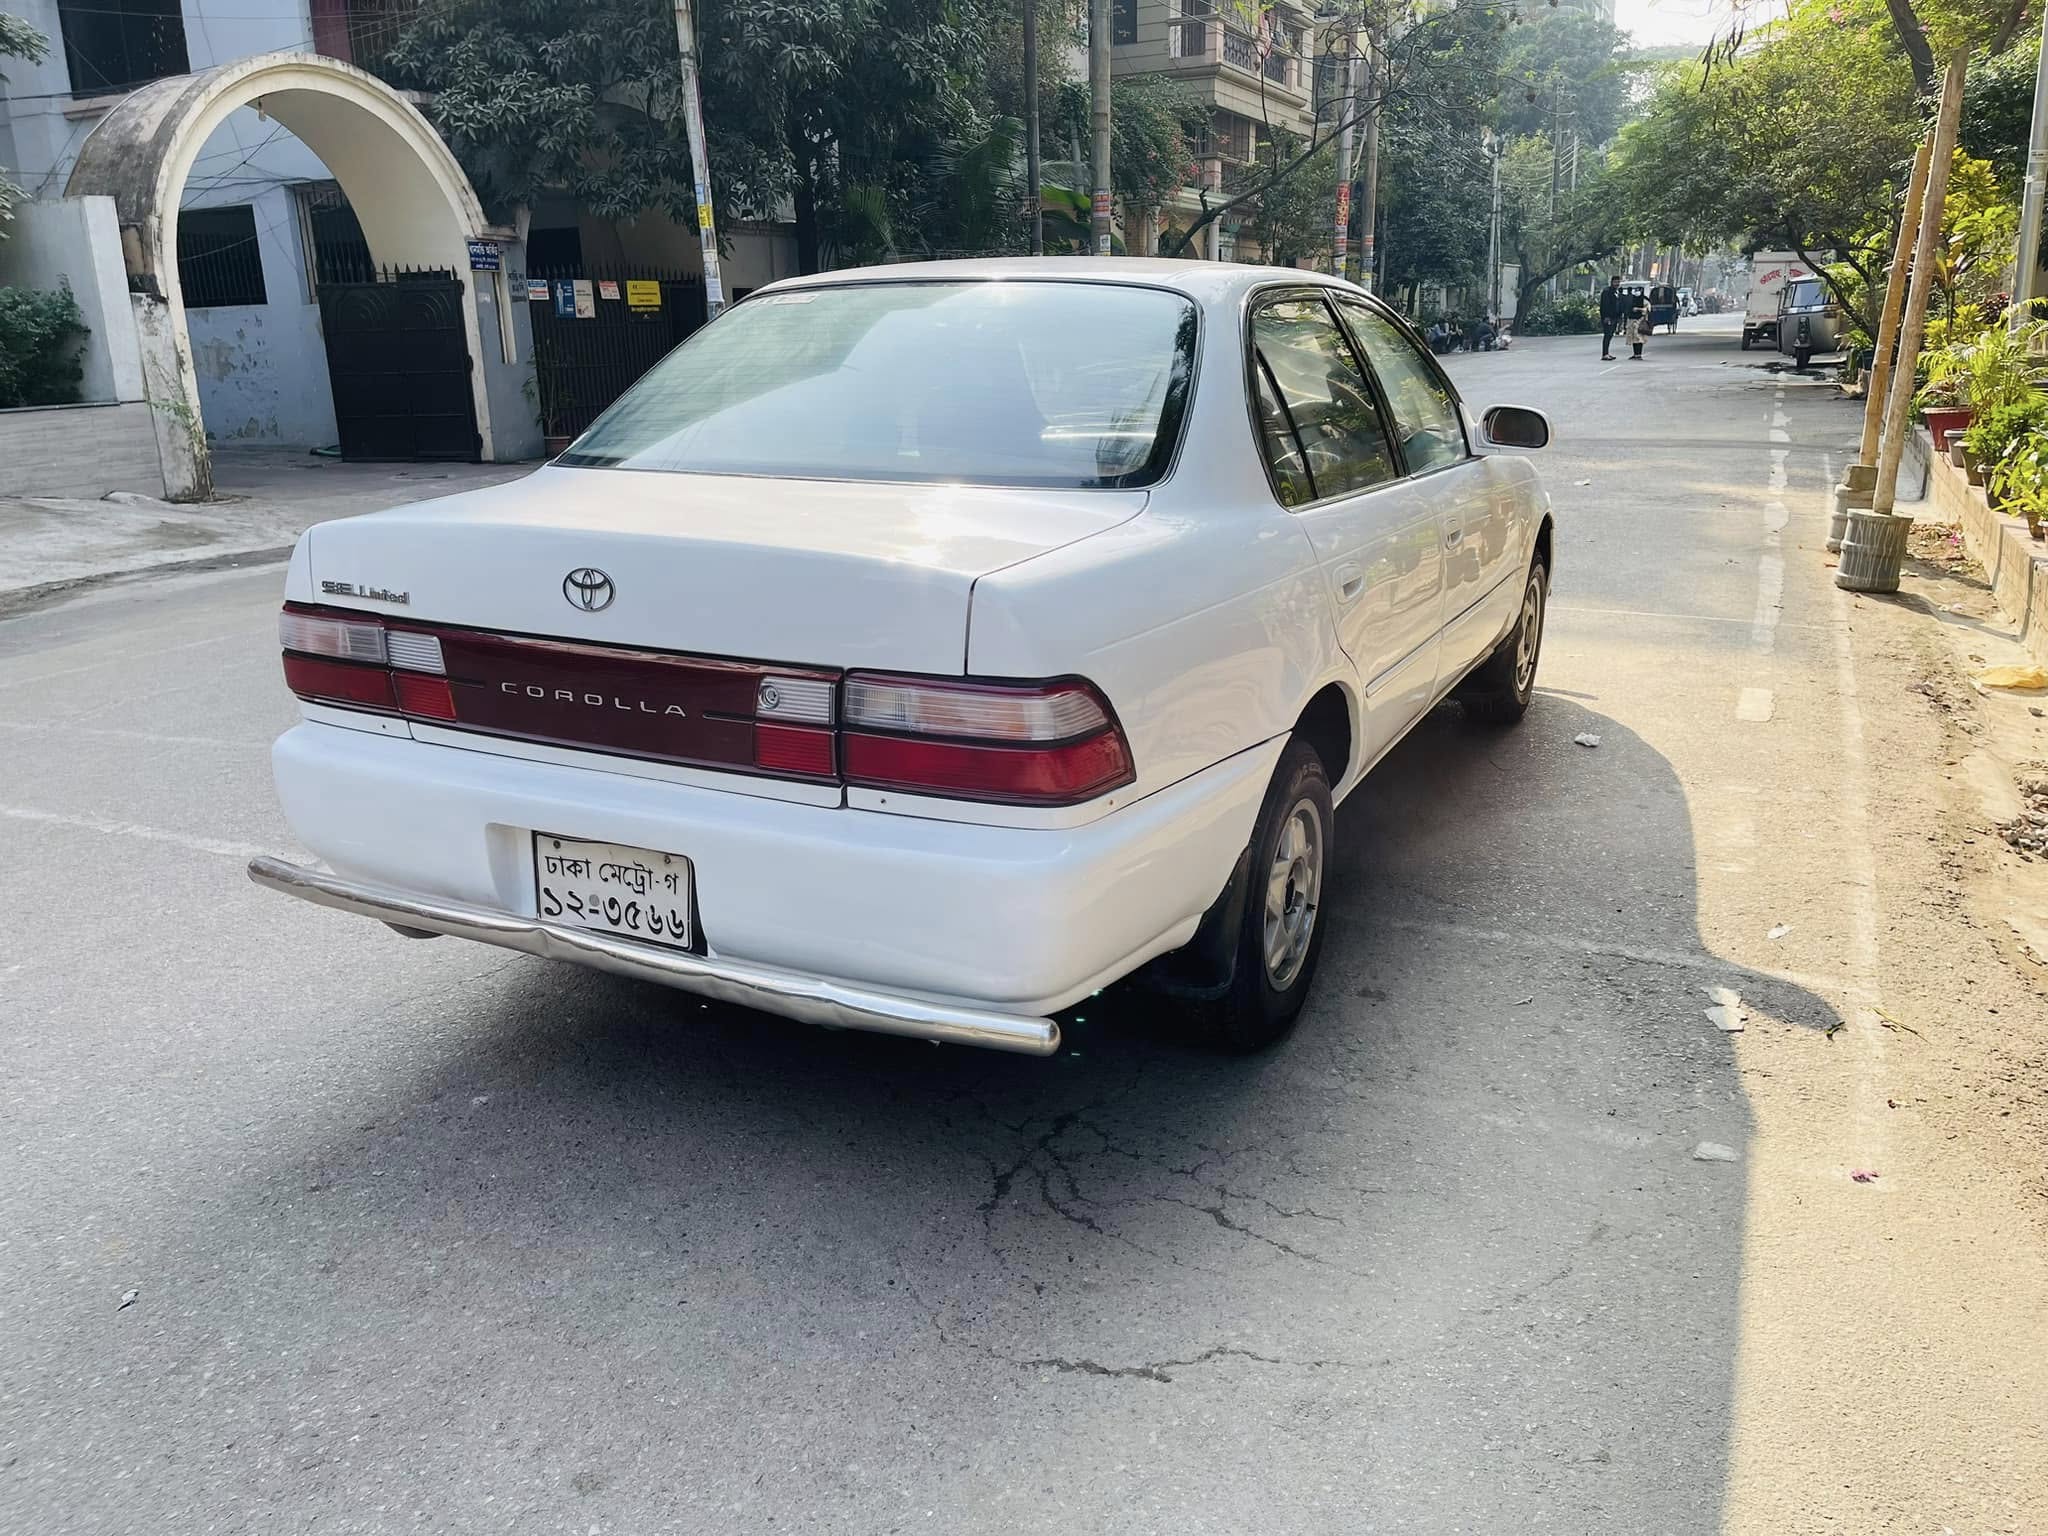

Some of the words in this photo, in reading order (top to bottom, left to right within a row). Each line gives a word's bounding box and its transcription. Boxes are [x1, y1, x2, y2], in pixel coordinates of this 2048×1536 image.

[359, 584, 410, 604] Limited
[501, 682, 686, 717] COROLLA
[544, 856, 592, 879] ঢাকা
[543, 887, 685, 939] ১২-৩৫৬৬
